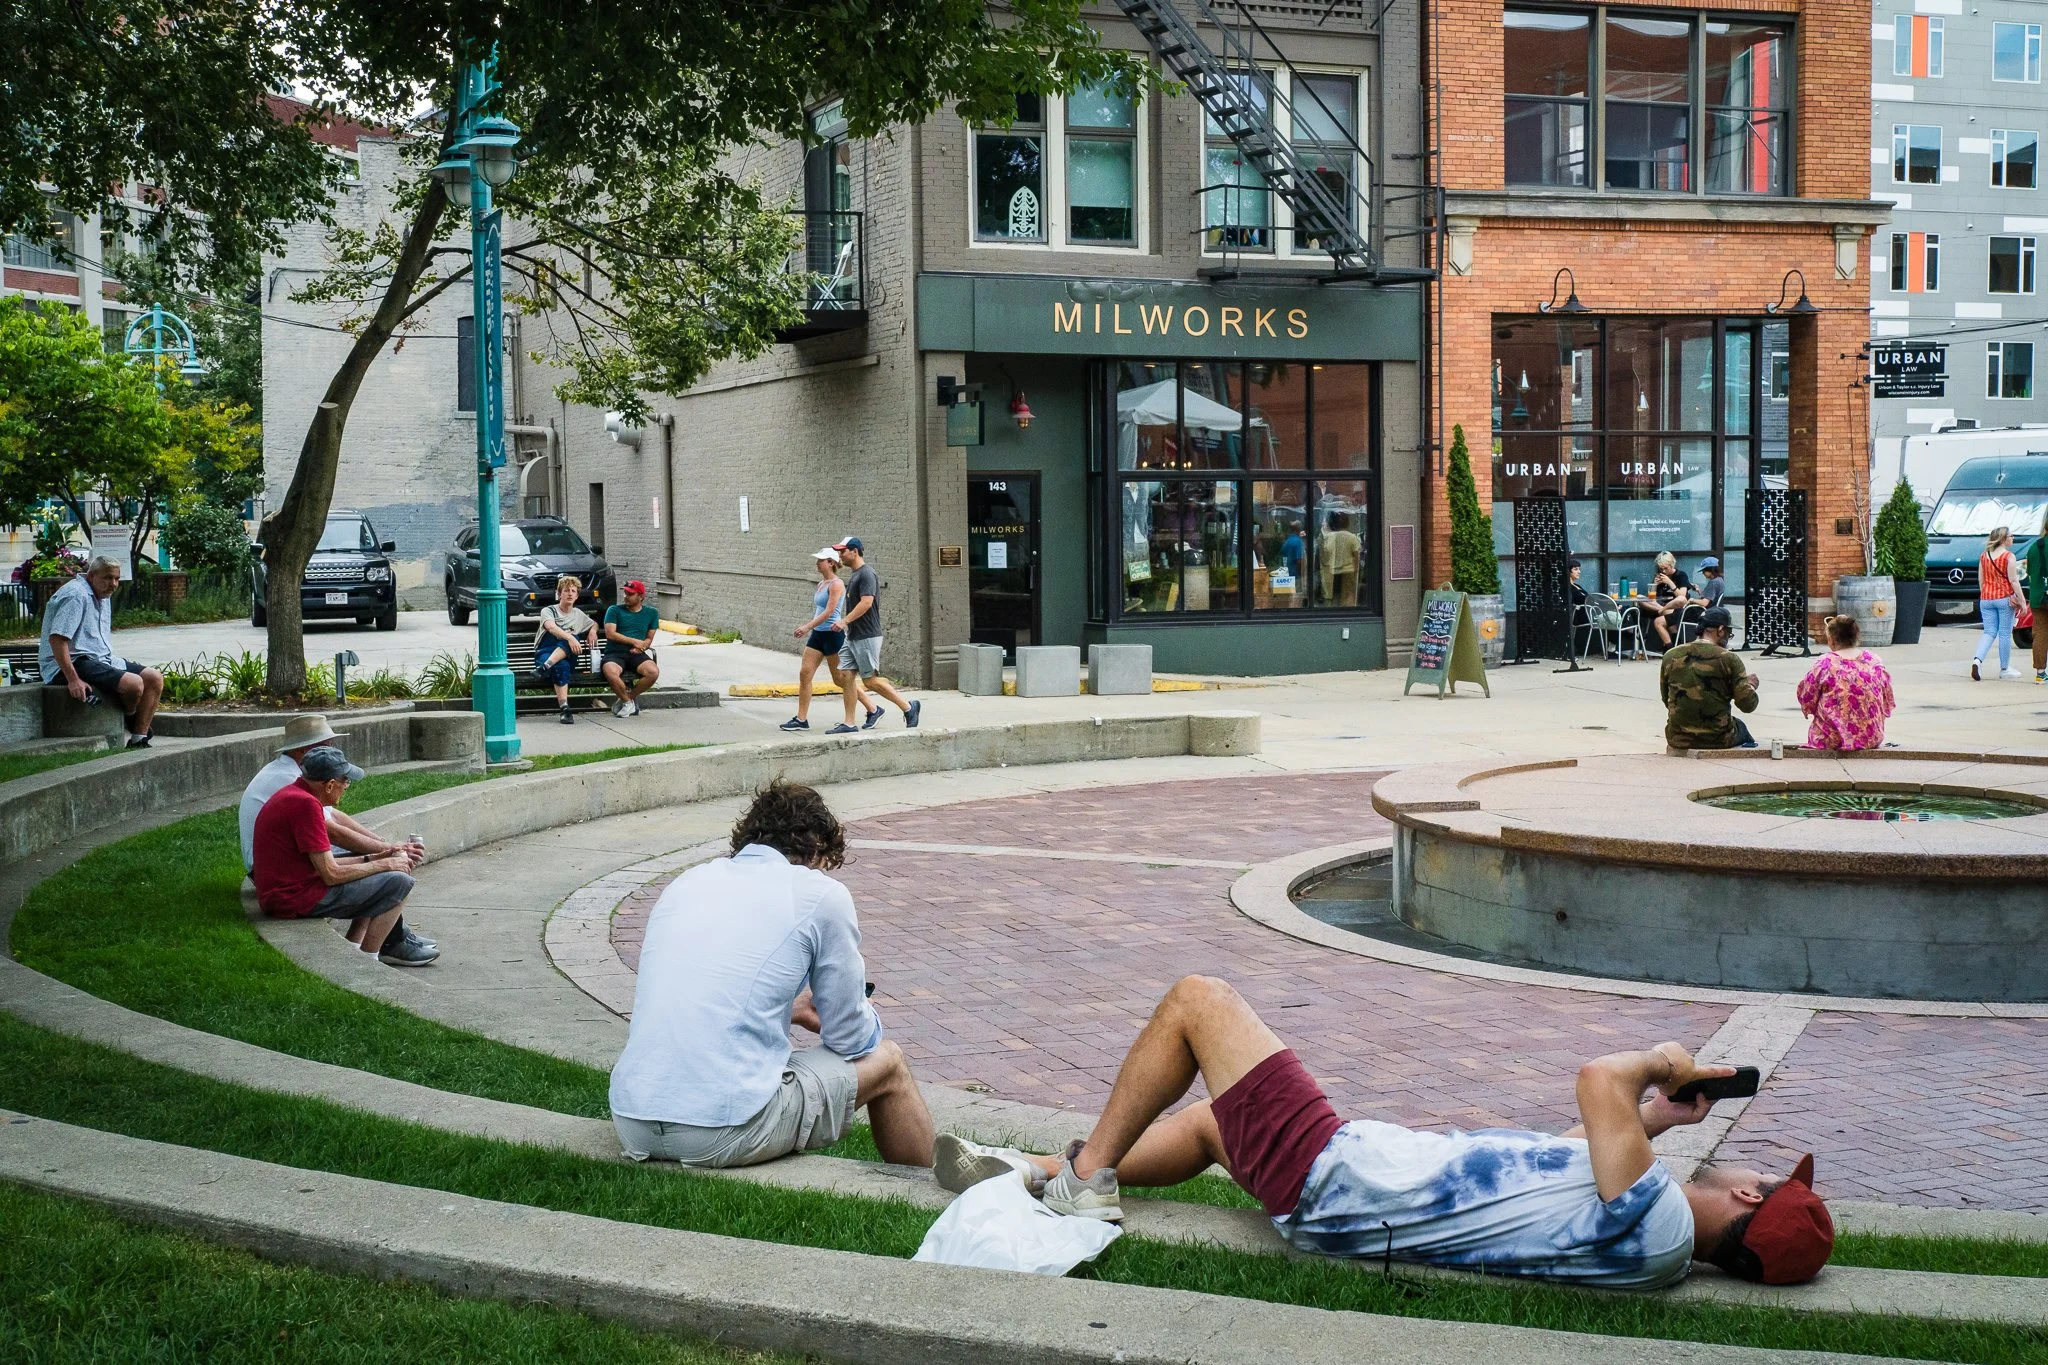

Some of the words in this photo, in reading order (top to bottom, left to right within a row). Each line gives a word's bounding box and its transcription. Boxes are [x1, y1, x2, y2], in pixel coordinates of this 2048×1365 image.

[1054, 302, 1308, 338] MILWORKS
[1879, 351, 1941, 364] URBAN
[1506, 463, 1571, 476] URBAN
[1621, 462, 1684, 475] URBAN
[989, 481, 1007, 491] 143
[971, 525, 1025, 534] MILWORKS
[1131, 571, 1149, 580] OPEN
